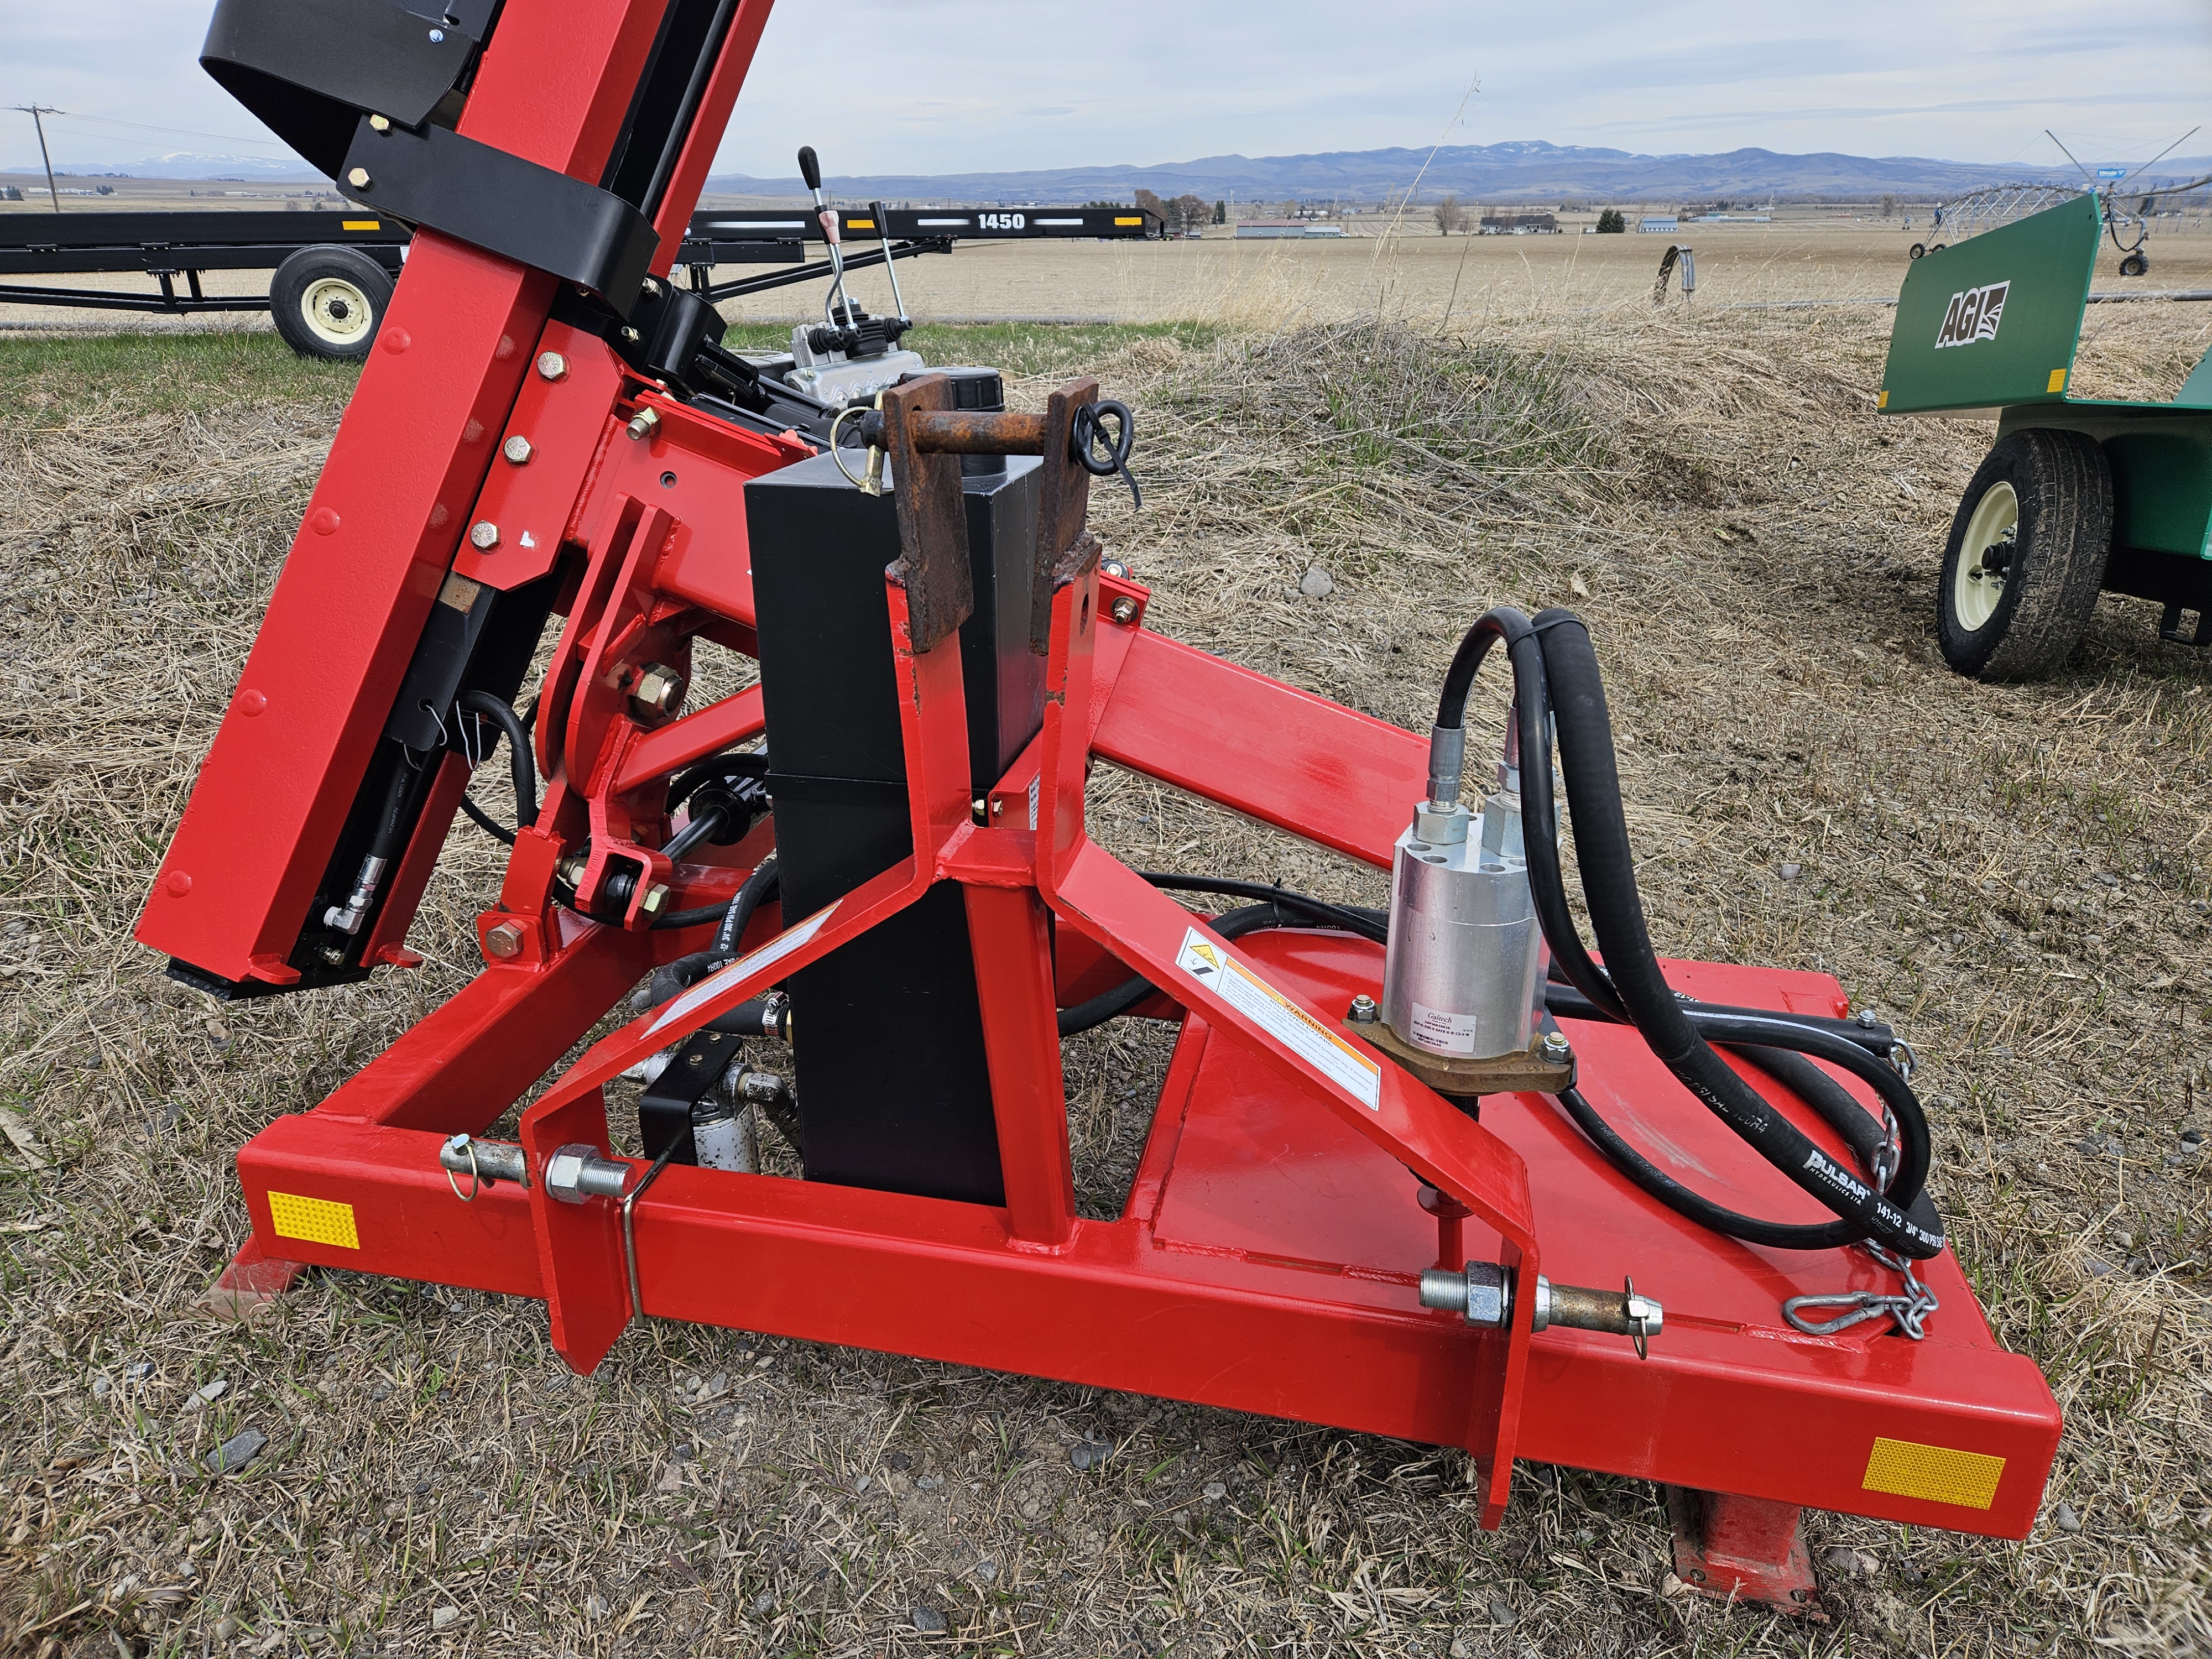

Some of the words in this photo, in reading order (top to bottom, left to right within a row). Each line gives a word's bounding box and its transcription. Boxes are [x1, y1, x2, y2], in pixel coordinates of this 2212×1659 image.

[978, 213, 1025, 229] 1450
[1937, 291, 1987, 345] AGI
[727, 904, 738, 915] SAE
[725, 914, 735, 923] PSI
[723, 922, 734, 932] 300
[707, 960, 723, 973] 100R4
[1273, 1006, 1287, 1019] injury
[1427, 1012, 1452, 1024] Galtech
[1269, 999, 1305, 1026] ROLLOVER
[1306, 1025, 1332, 1047] HAZARD
[1285, 1001, 1332, 1040] WARNING
[1809, 1167, 1850, 1197] HYDRAULICS
[1850, 1194, 1862, 1206] LTD.
[1876, 1202, 1902, 1228] 141-12
[1906, 1221, 1919, 1237] 3/4"
[1919, 1229, 1929, 1244] 300
